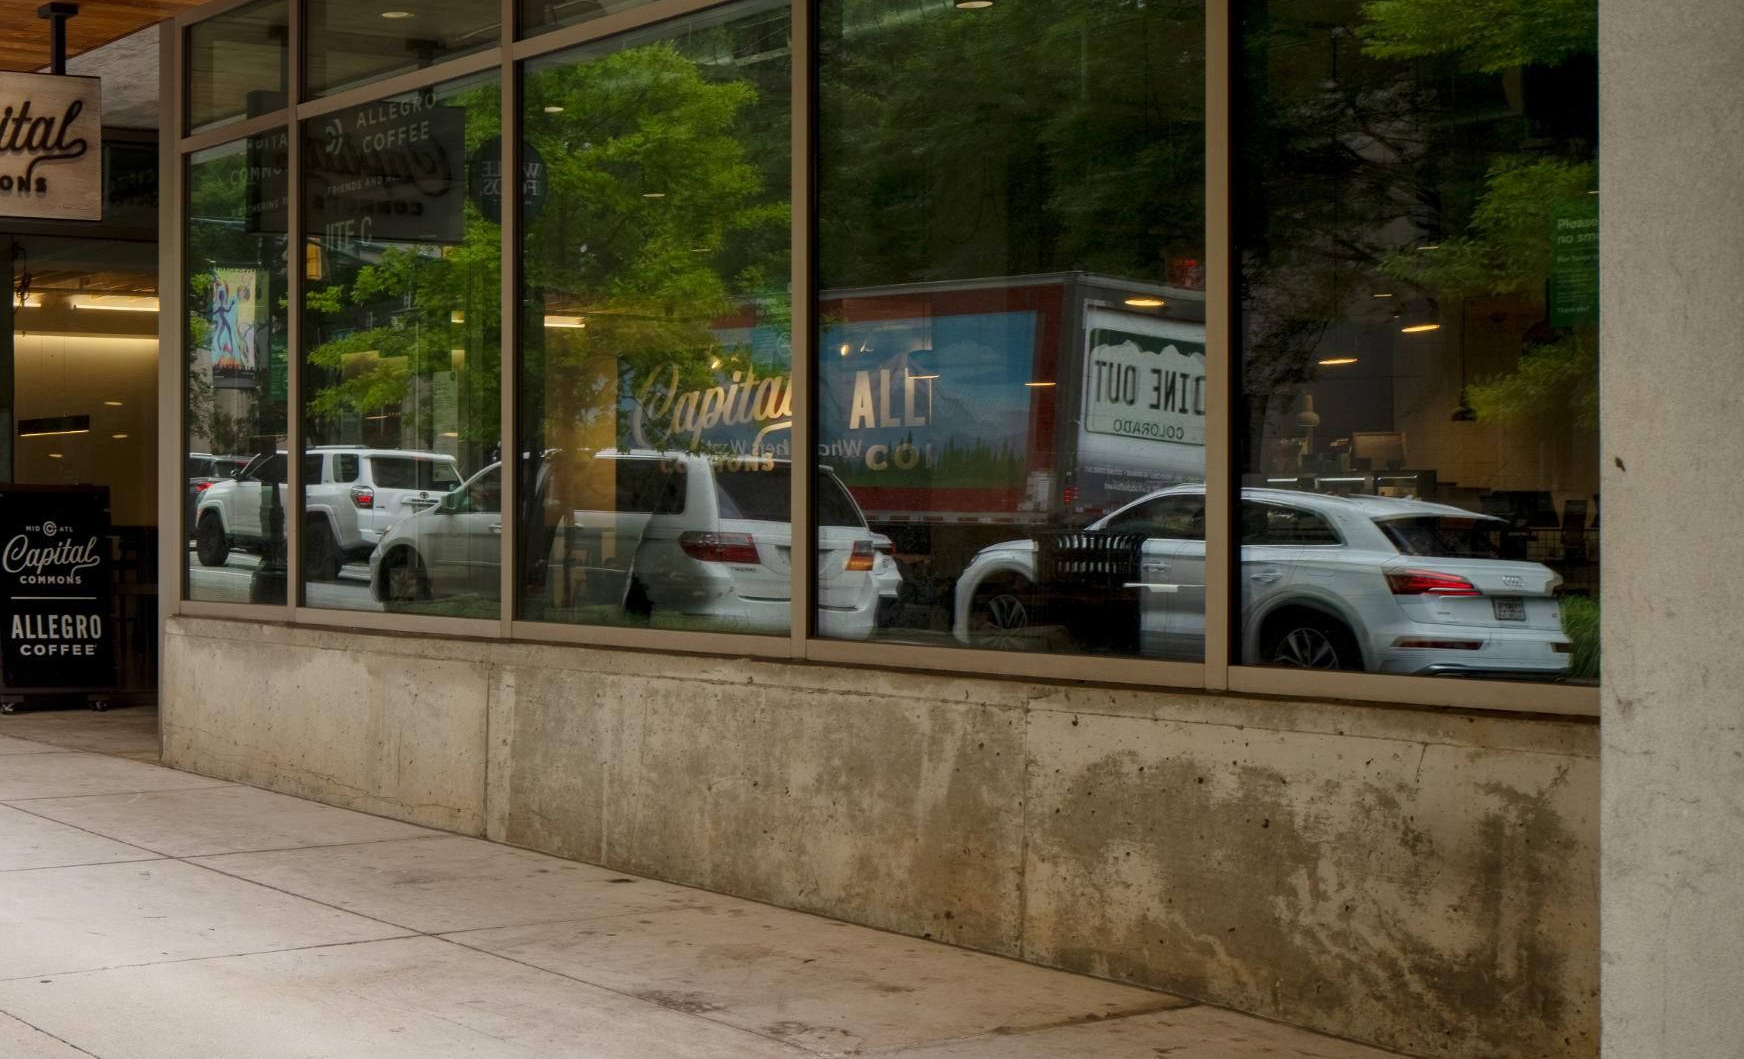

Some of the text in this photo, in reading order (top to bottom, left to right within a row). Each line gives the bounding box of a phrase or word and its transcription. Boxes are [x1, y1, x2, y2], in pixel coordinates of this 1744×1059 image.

[356, 93, 436, 129] ALLEGRO
[362, 121, 430, 154] COFFEE
[2, 534, 101, 575] Capital
[19, 575, 83, 584] COMMONS
[11, 614, 102, 640] ALLEGRO
[19, 644, 96, 656] COFFEE
